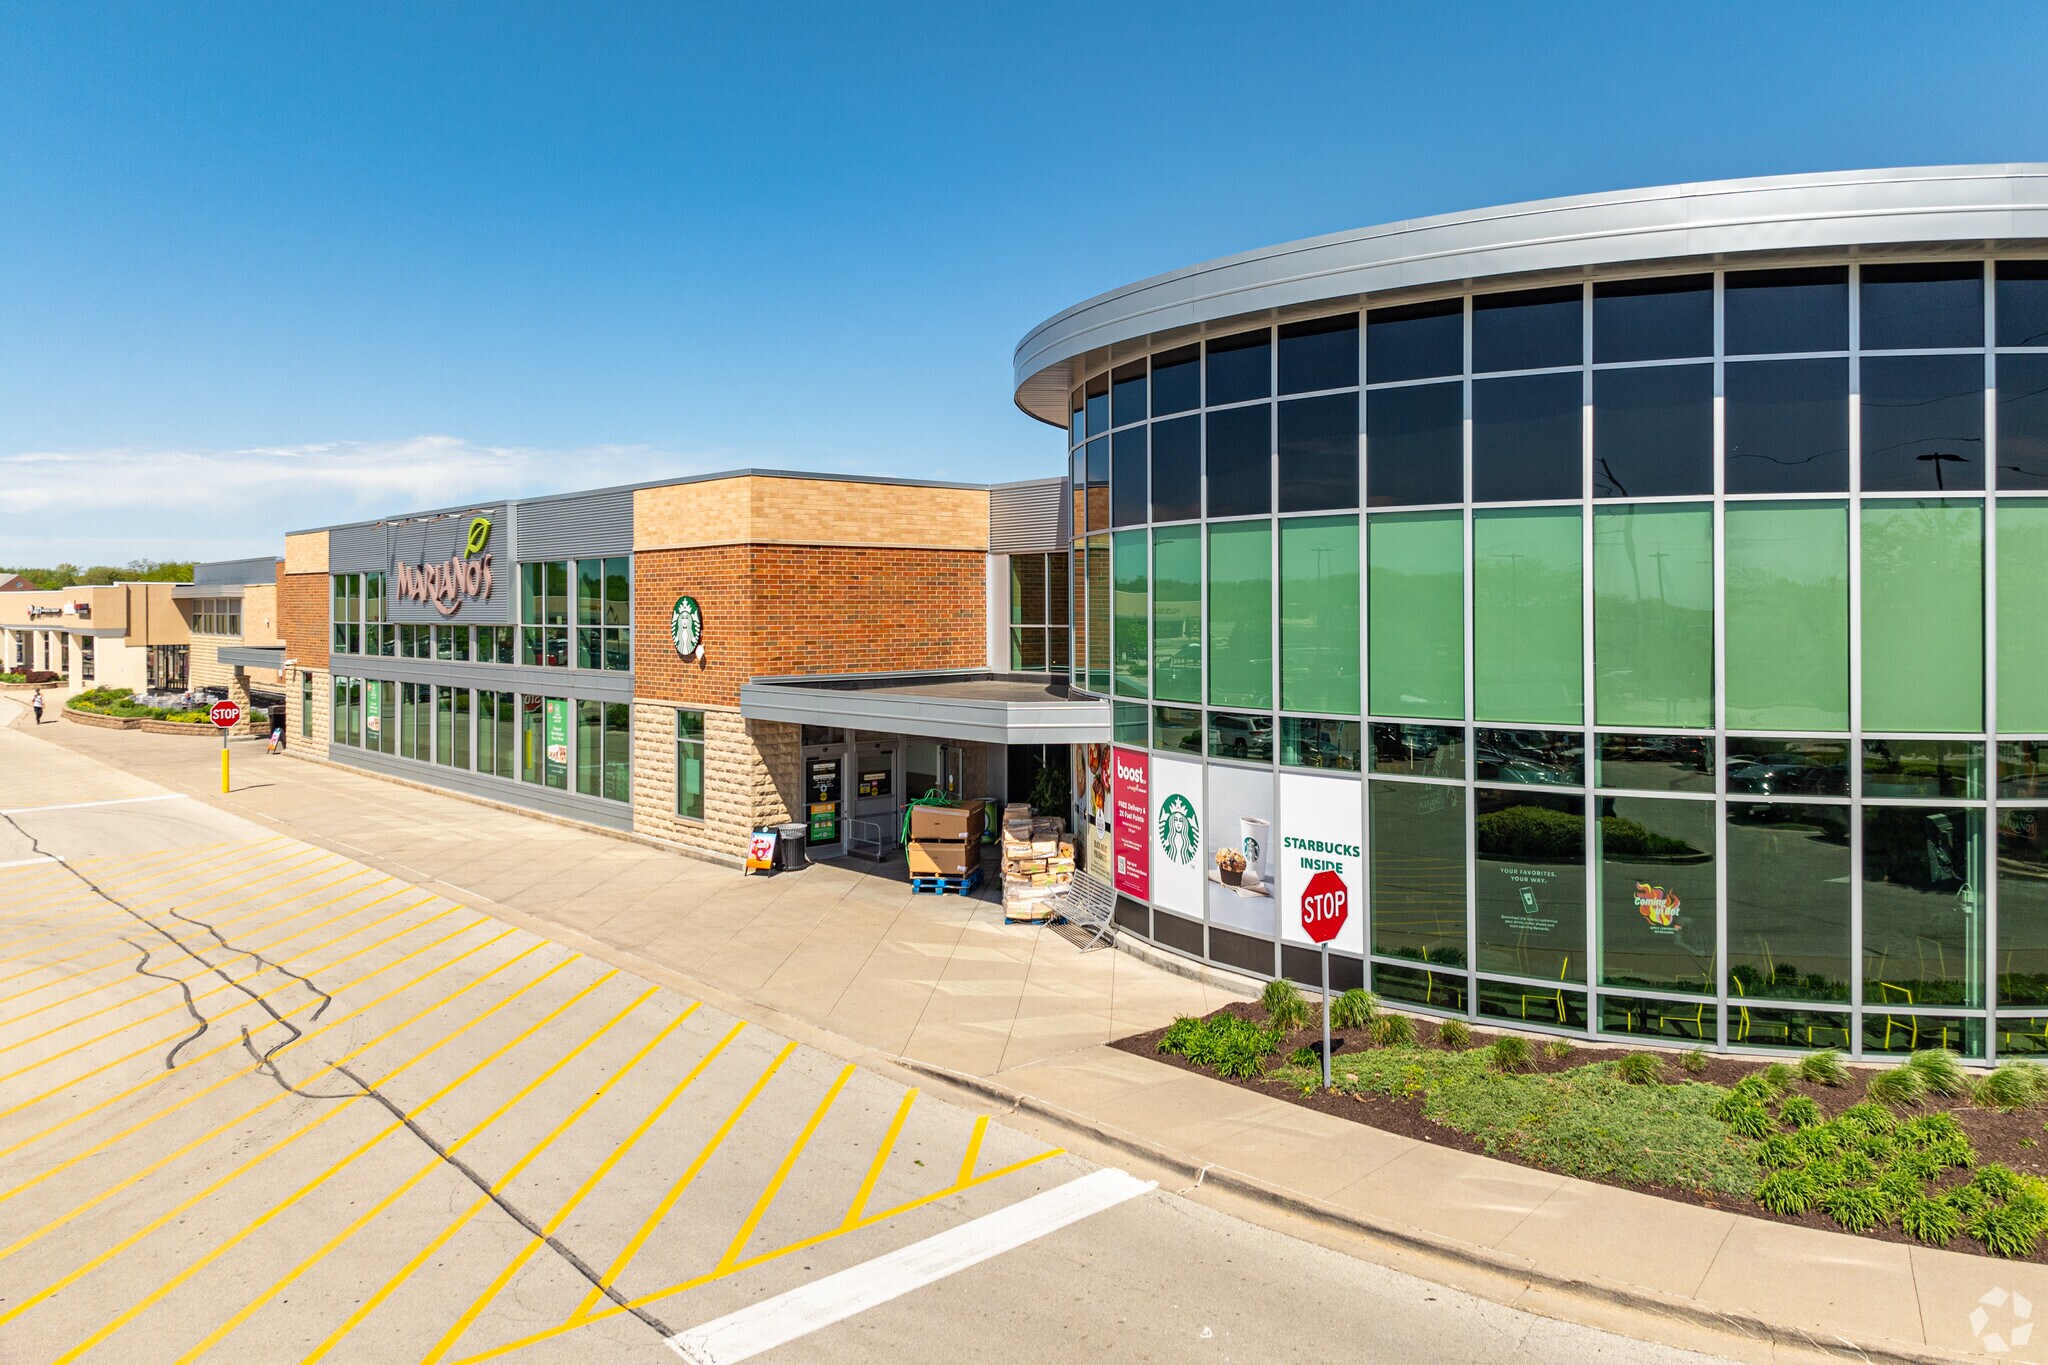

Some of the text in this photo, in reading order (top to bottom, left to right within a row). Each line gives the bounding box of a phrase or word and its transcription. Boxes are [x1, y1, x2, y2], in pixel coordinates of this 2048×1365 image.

[212, 708, 239, 720] STOP
[1118, 800, 1128, 809] FREE
[1128, 802, 1143, 814] Delivery
[1125, 811, 1133, 819] Fuel
[1133, 813, 1145, 823] Points
[1284, 837, 1360, 857] STARBUCKS
[1301, 857, 1343, 874] INSIDE
[1304, 890, 1345, 924] STOP
[1634, 897, 1667, 908] Coming
[1665, 907, 1680, 916] Hot
